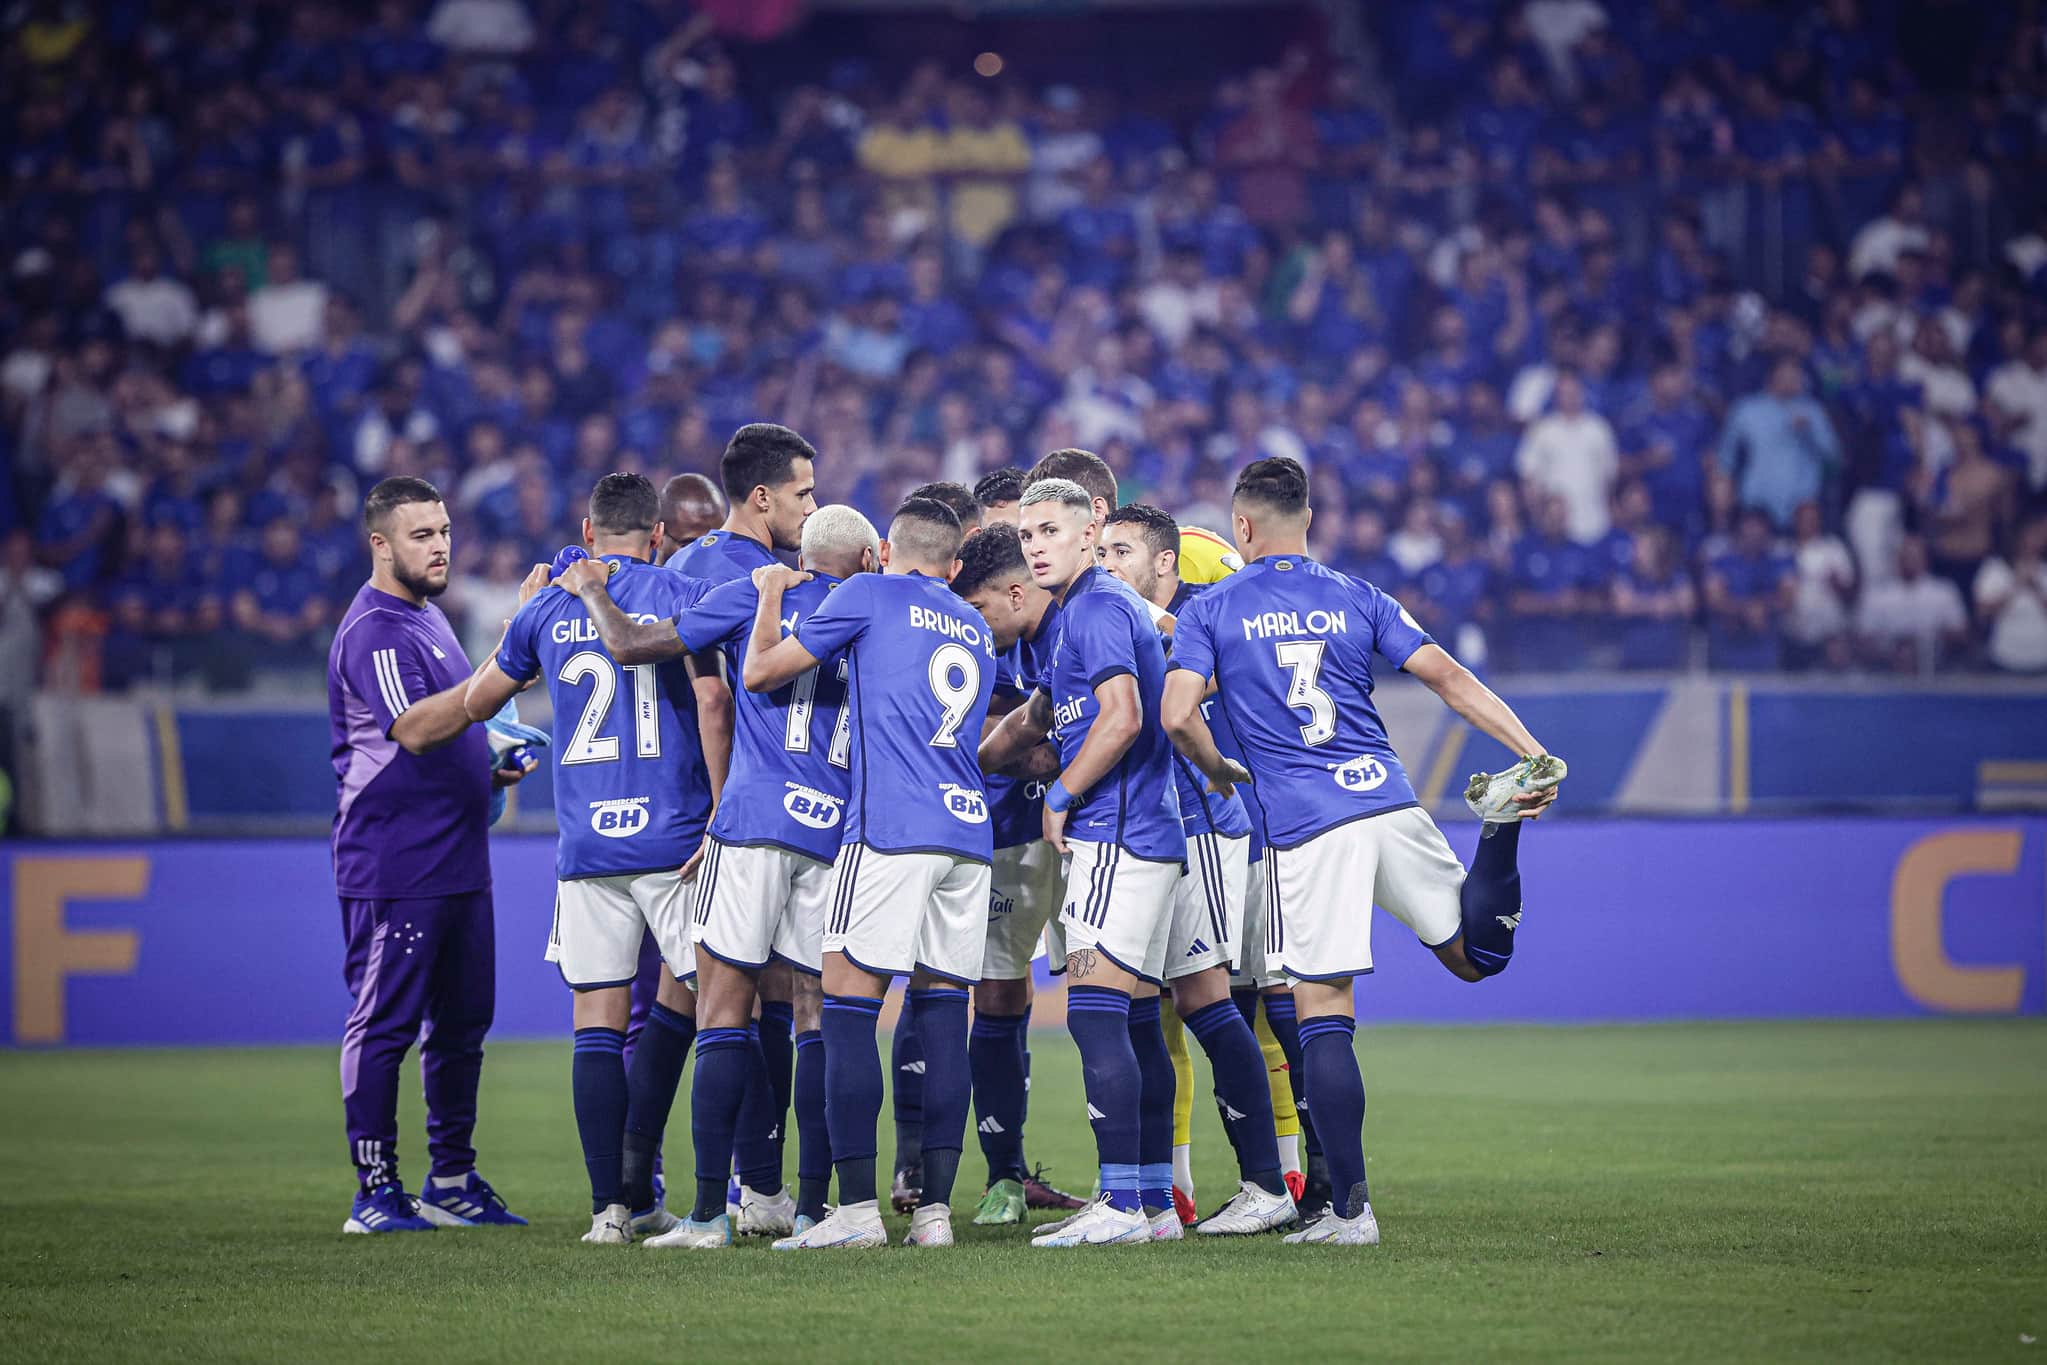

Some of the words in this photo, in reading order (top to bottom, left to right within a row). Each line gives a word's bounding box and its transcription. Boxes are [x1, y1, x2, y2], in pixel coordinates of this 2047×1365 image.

[909, 605, 980, 646] BRUNO
[1242, 610, 1347, 640] MARLON
[558, 651, 660, 765] 21
[928, 643, 980, 748] 9
[1275, 640, 1336, 747] 3
[1343, 763, 1381, 786] BH
[599, 809, 641, 830] BH
[790, 795, 835, 823] BH
[951, 795, 983, 817] BH
[13, 856, 151, 1044] F
